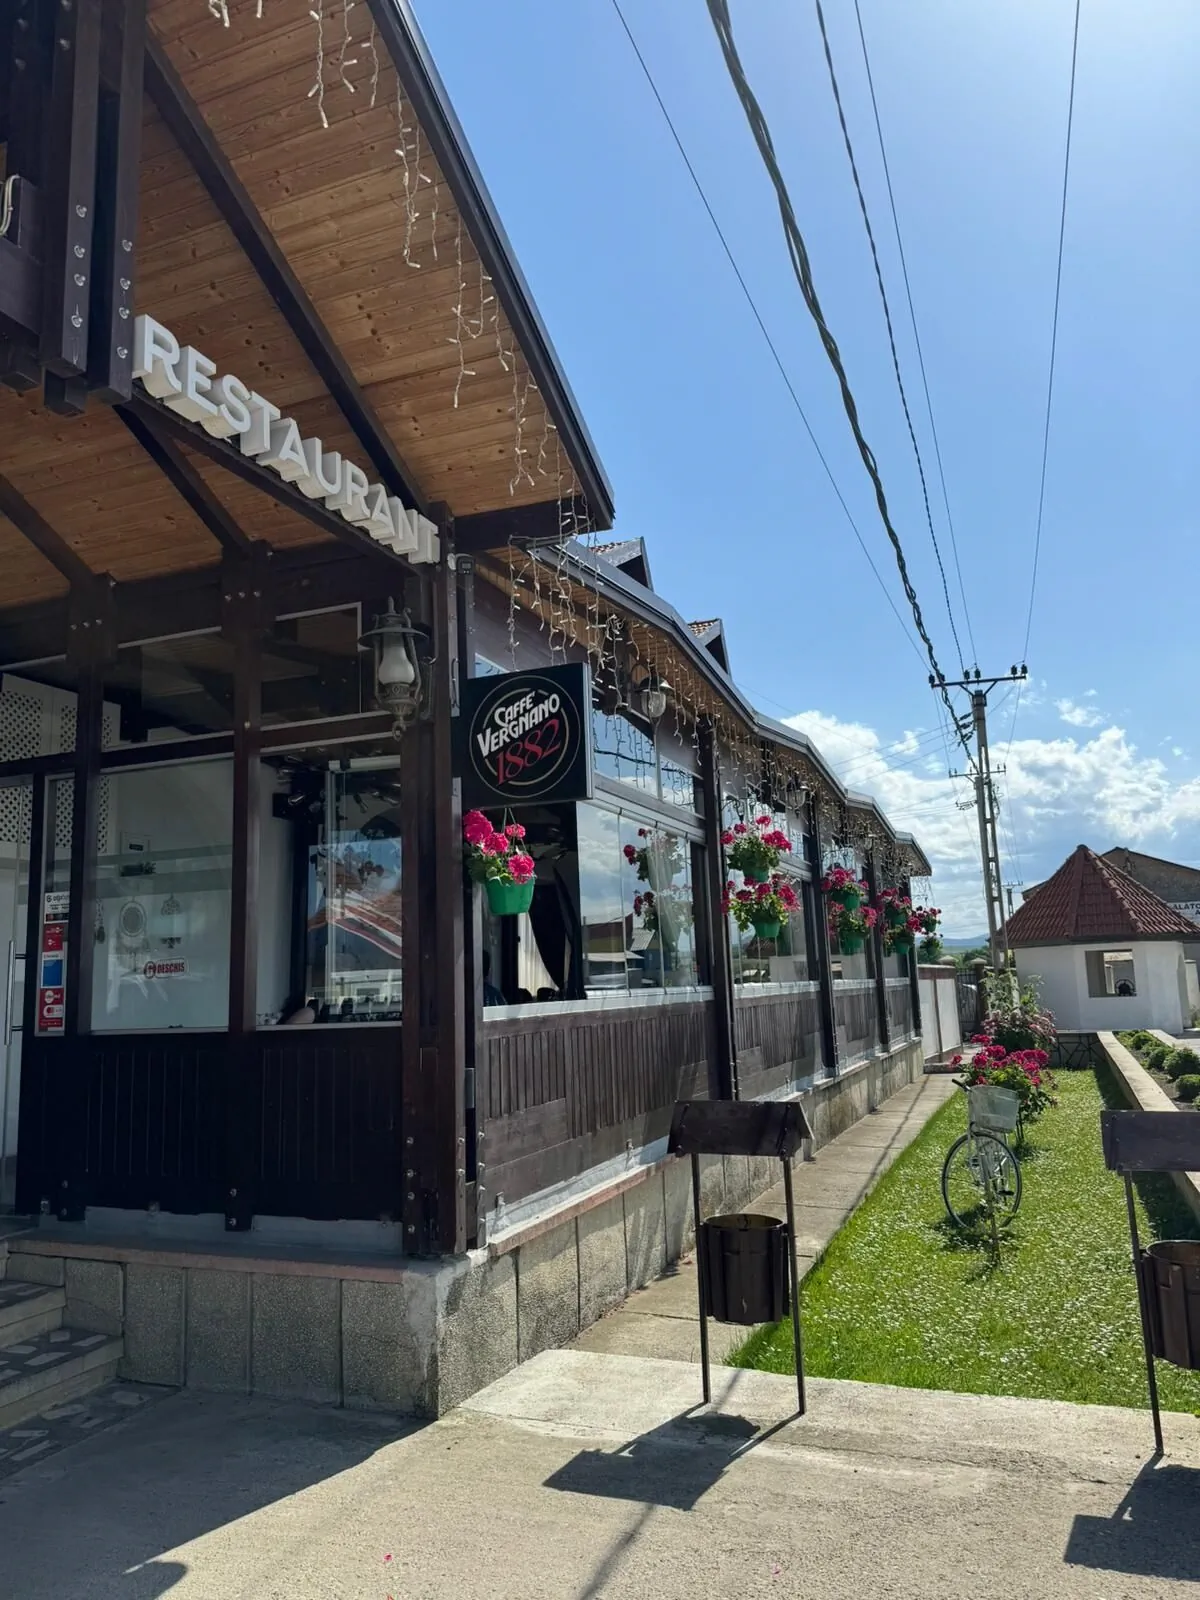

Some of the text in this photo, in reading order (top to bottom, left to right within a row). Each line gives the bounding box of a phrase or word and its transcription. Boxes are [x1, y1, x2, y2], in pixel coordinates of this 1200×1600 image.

[132, 314, 440, 564] RESTAURANT
[477, 693, 560, 758] VERGNANO
[496, 718, 561, 785] 1882
[157, 962, 185, 973] DESCHIS
